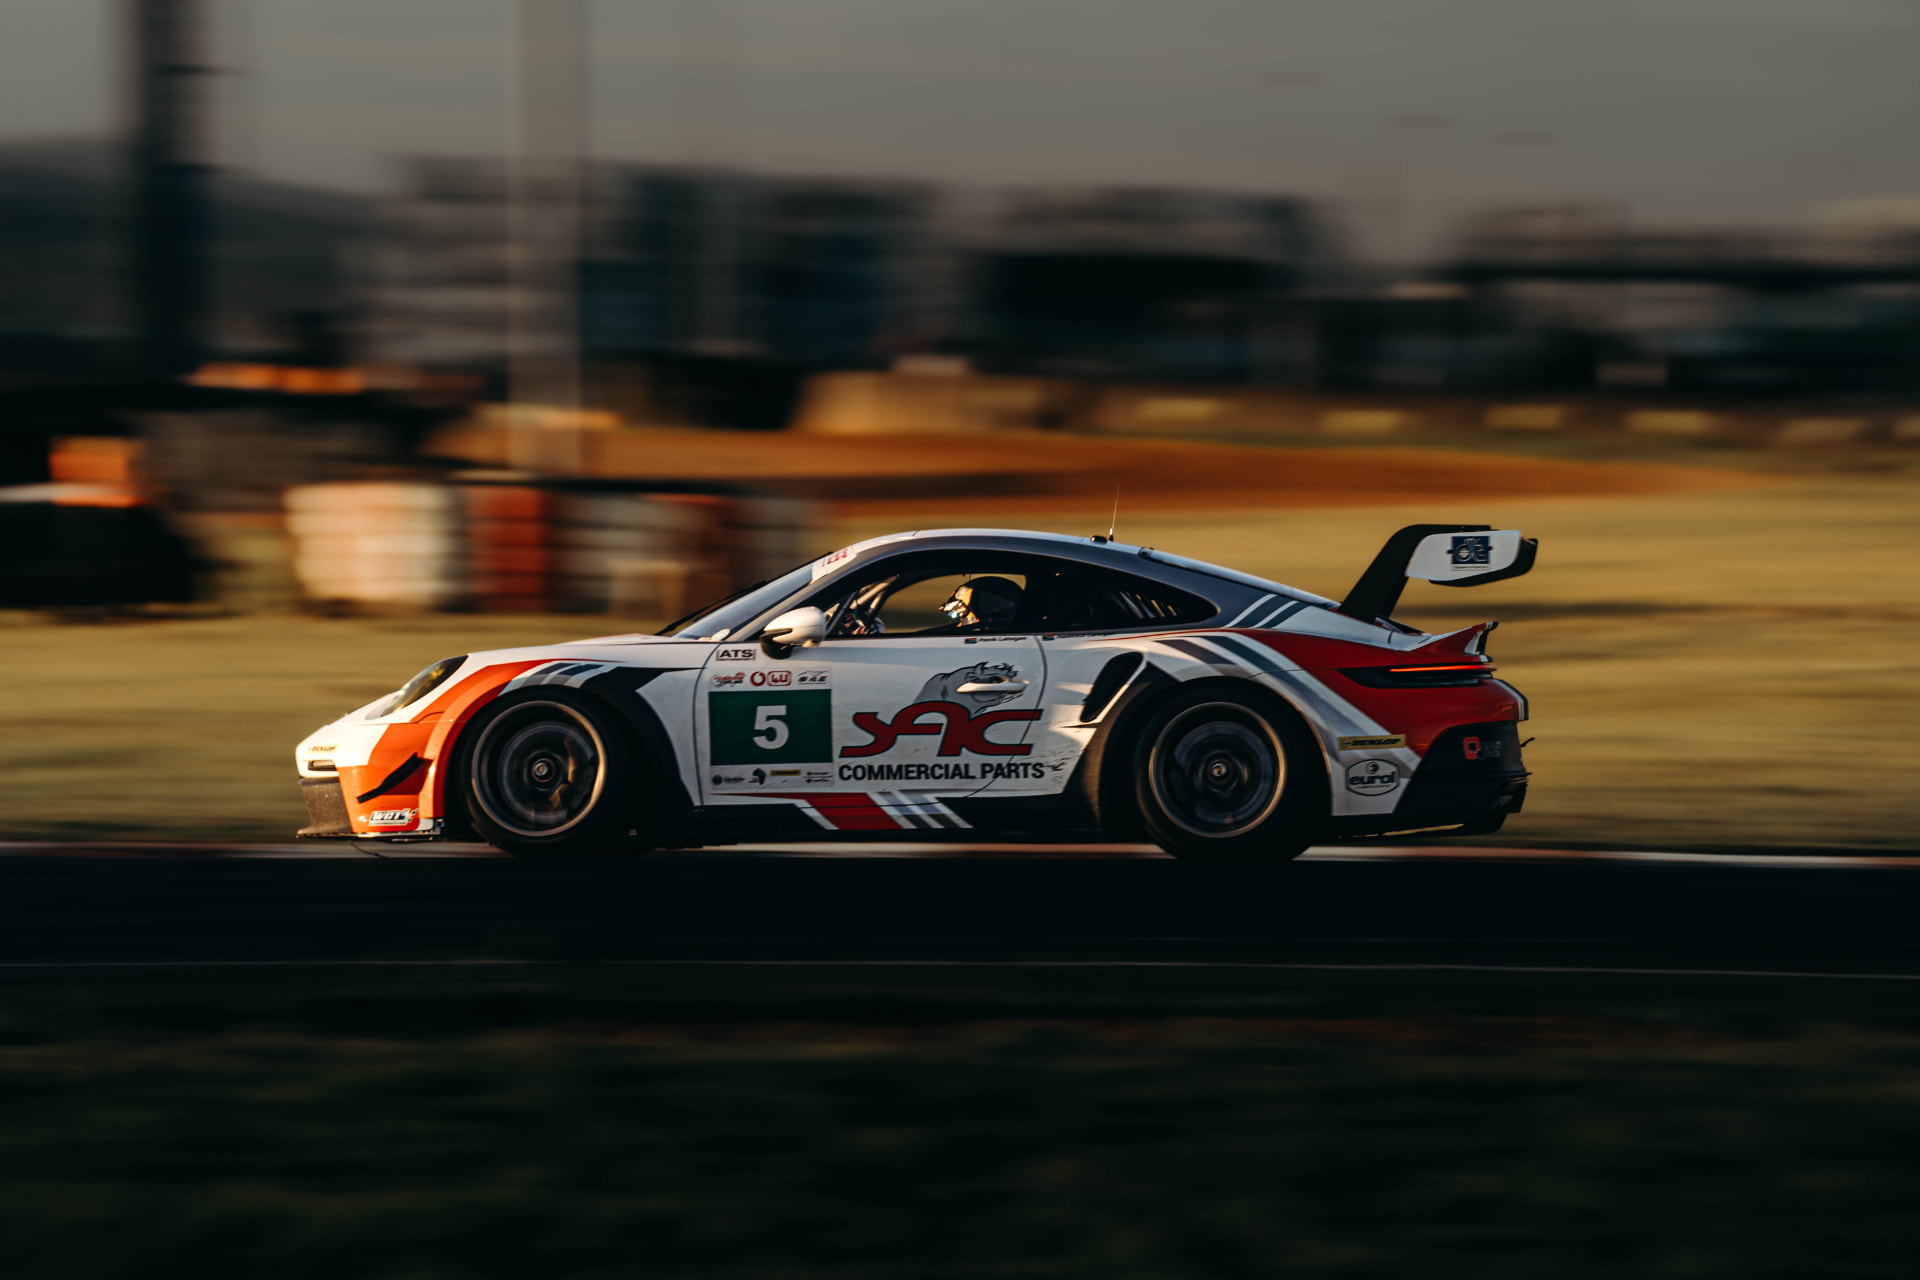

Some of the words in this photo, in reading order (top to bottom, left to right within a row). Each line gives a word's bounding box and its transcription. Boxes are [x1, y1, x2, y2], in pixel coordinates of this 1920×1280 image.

[720, 649, 753, 658] ATS
[752, 705, 789, 749] 5
[838, 700, 1044, 758] SAC
[838, 763, 975, 782] COMMERCIAL
[981, 762, 1045, 780] PARTS
[1350, 771, 1396, 785] eurol
